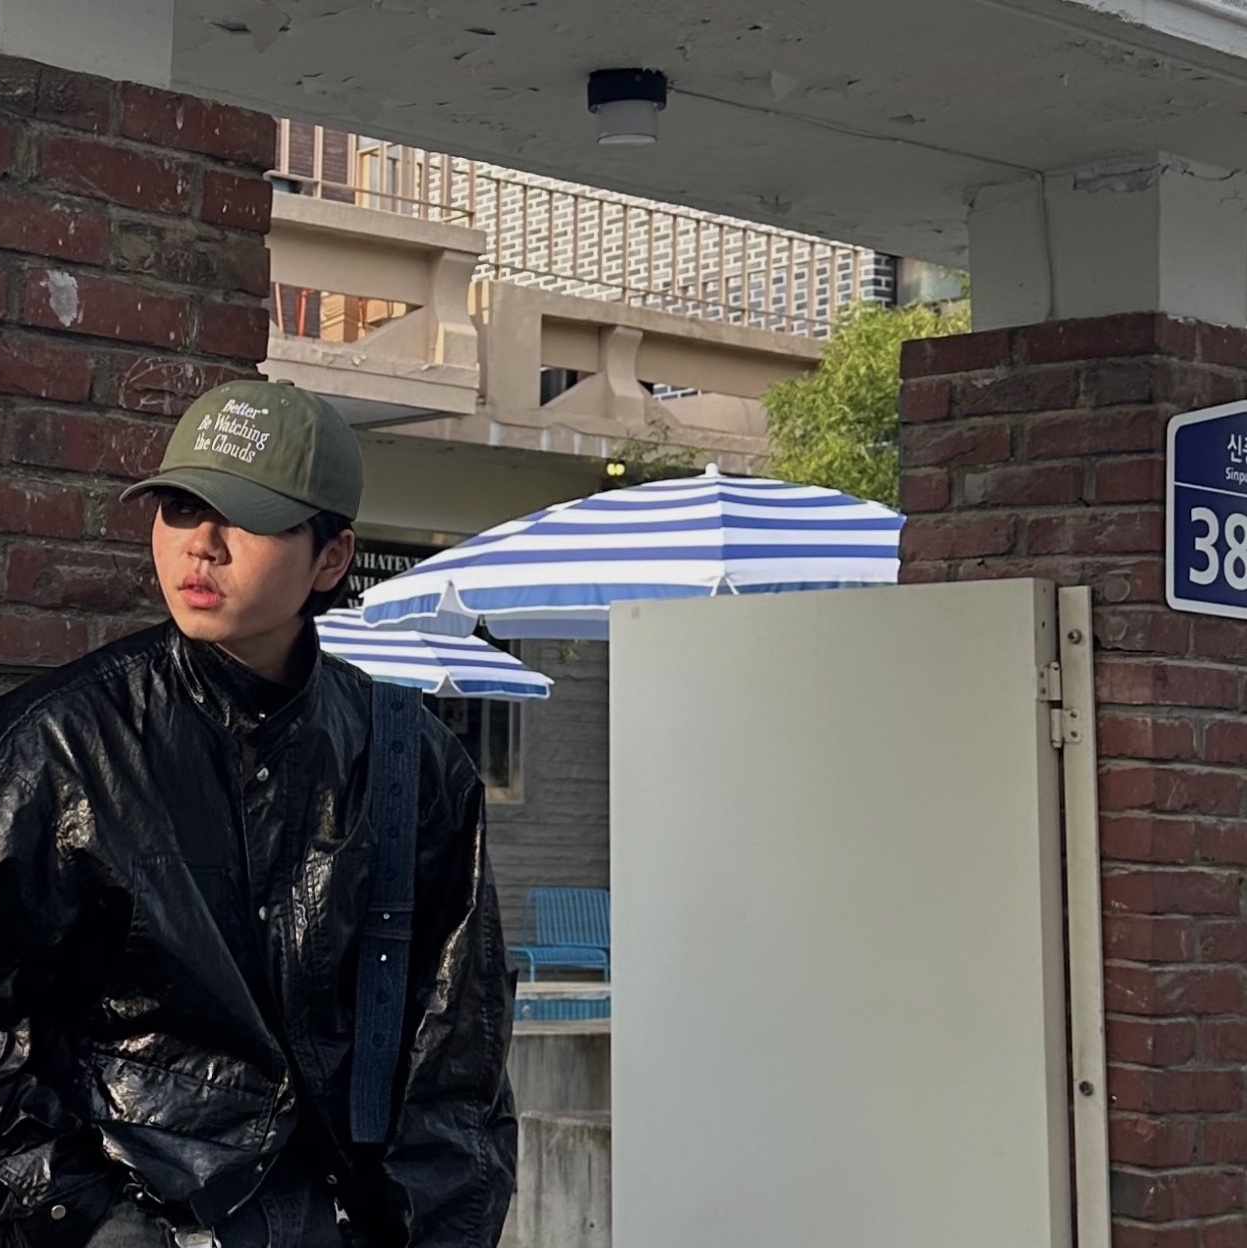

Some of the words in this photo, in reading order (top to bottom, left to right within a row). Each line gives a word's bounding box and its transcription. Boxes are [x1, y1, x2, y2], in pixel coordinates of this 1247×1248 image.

[222, 399, 261, 419] Better
[194, 431, 211, 450] the
[212, 433, 256, 463] Clouds
[197, 414, 212, 430] Be
[214, 413, 270, 451] Watching
[1226, 433, 1247, 464] 신
[1188, 507, 1247, 590] 38
